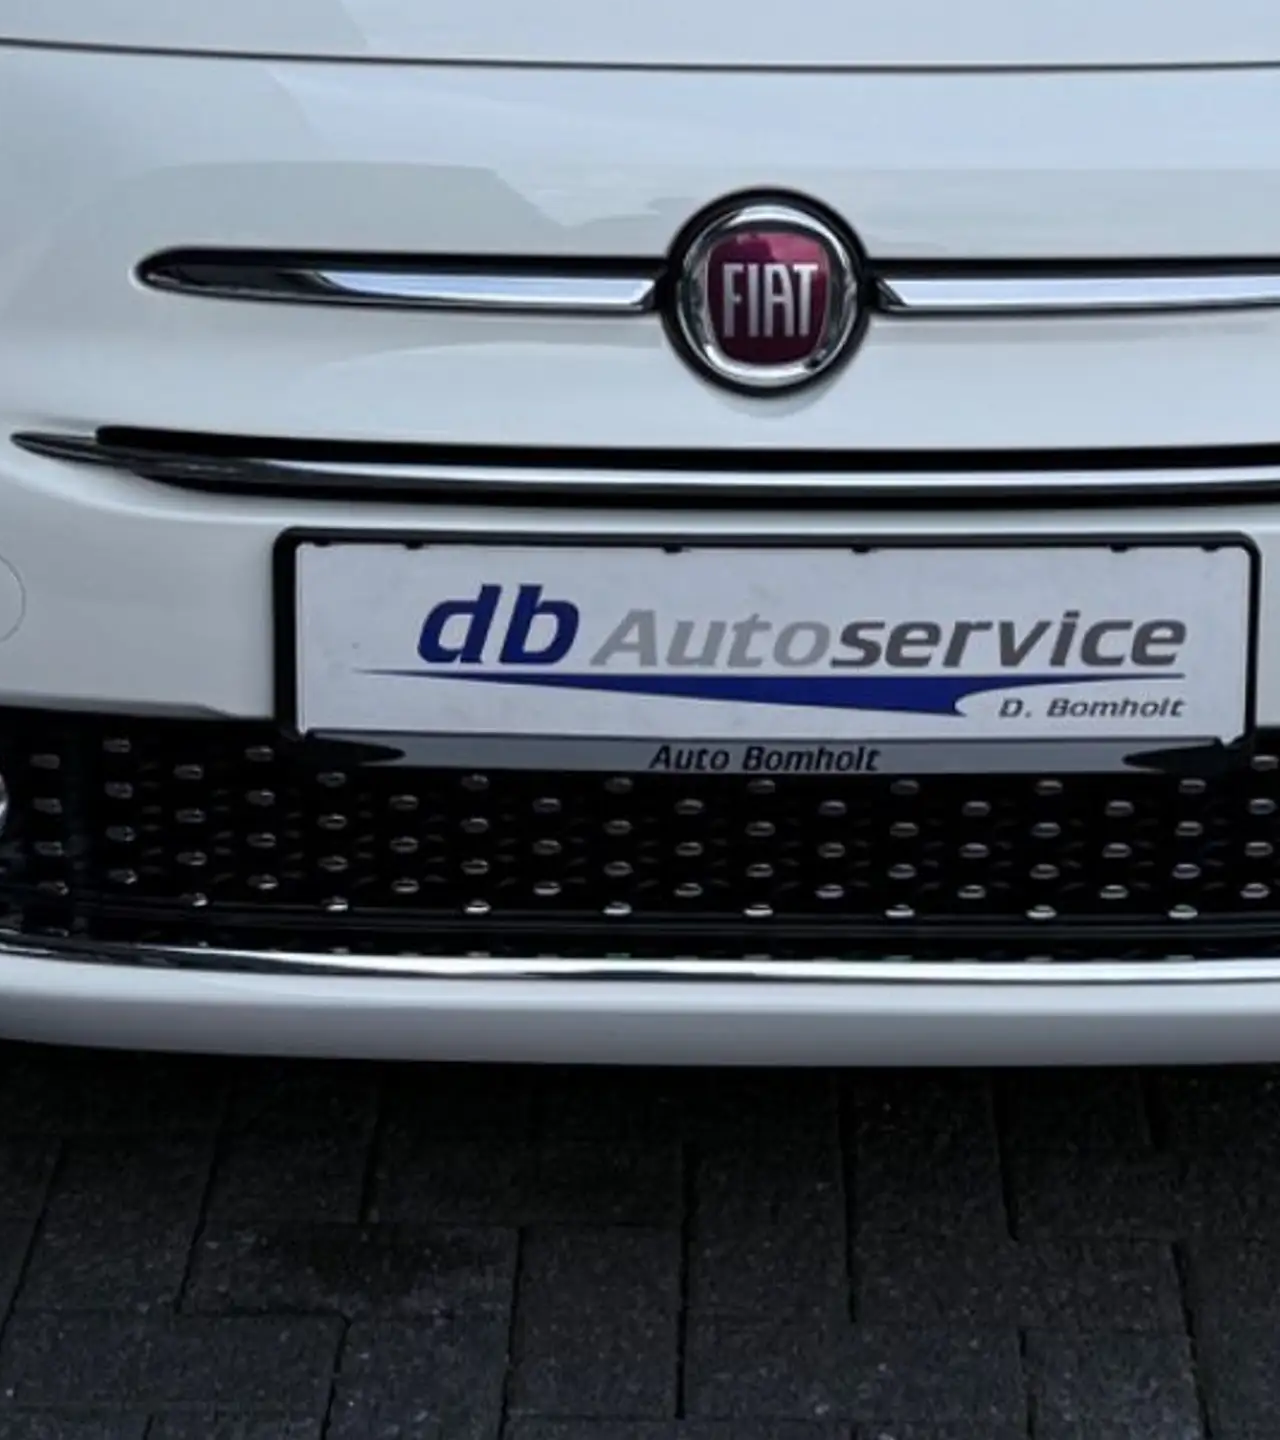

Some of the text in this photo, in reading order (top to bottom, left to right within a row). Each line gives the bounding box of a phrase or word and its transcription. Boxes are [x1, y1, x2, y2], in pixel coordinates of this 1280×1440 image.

[723, 263, 818, 337] FIAT
[417, 584, 1187, 668] db Autoservice
[998, 697, 1184, 718] D. Bomholt
[648, 745, 880, 772] Auto Bomholt
